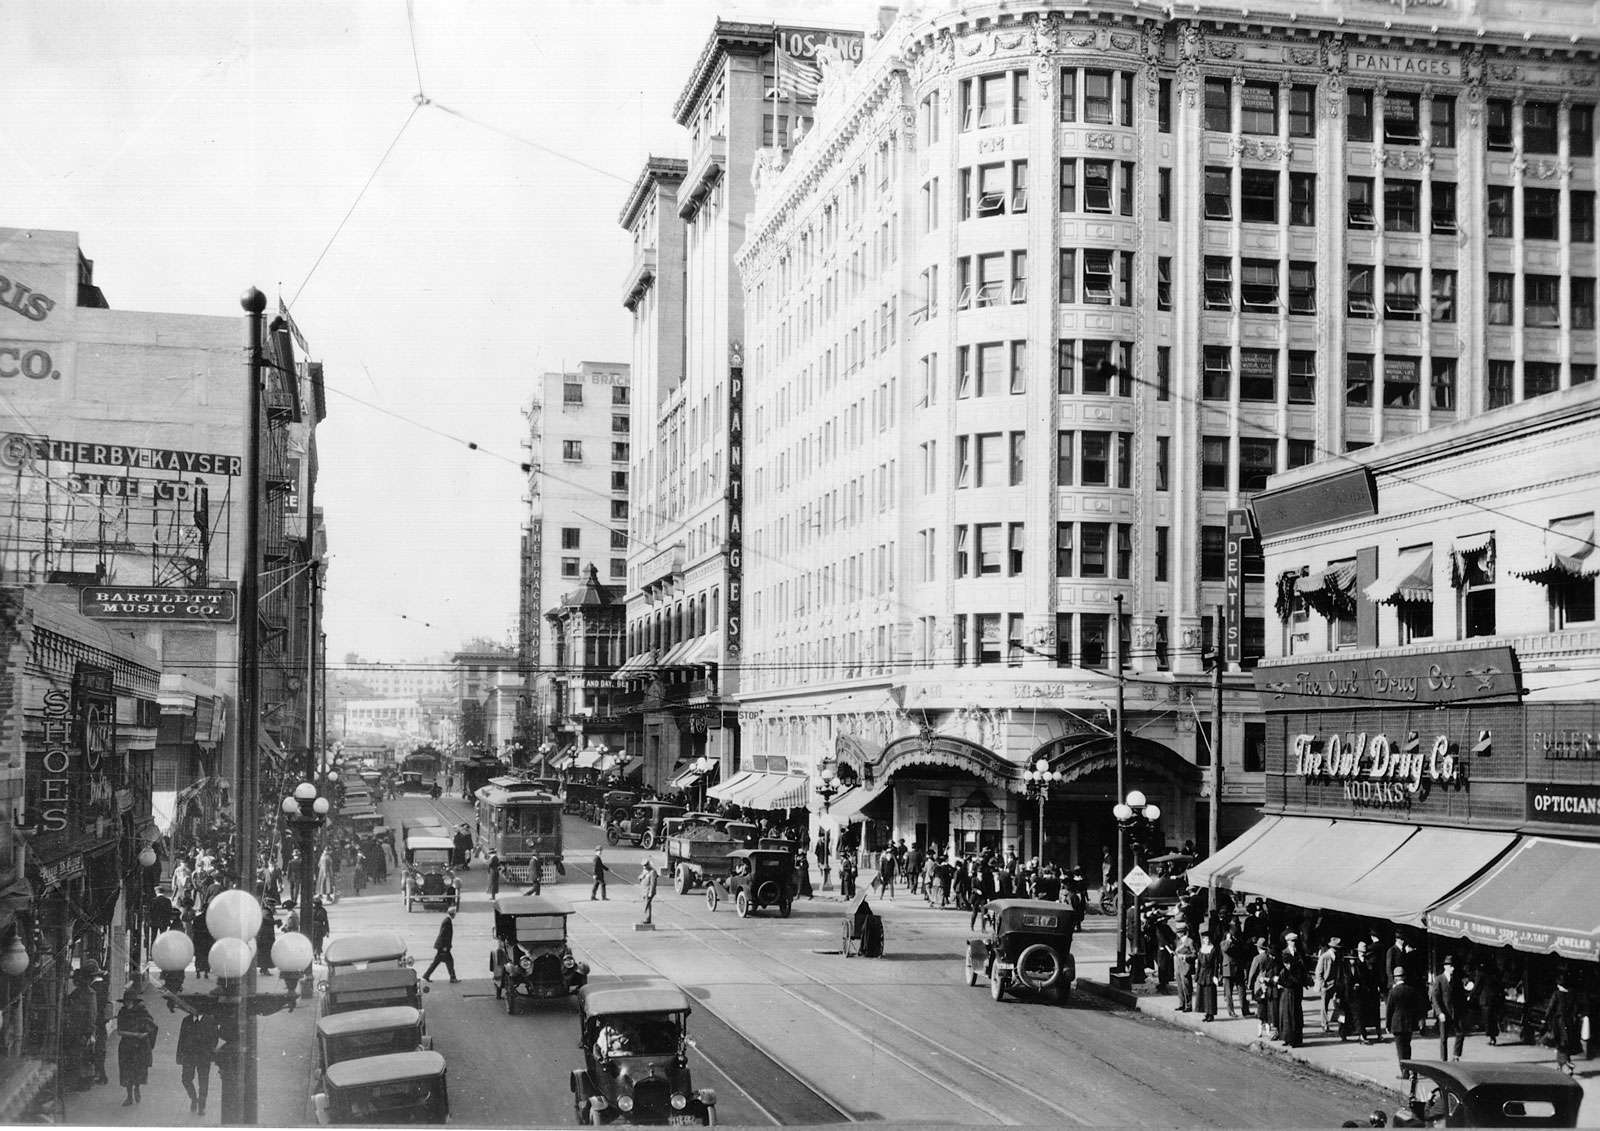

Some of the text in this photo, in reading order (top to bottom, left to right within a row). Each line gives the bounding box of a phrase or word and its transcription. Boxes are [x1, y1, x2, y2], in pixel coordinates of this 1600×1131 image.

[780, 33, 815, 56] LOS
[1356, 55, 1451, 75] PANTAGES
[729, 379, 741, 635] PANTAGES
[96, 592, 222, 604] BARTLETT
[101, 603, 220, 614] MUSIC CO.
[1228, 541, 1238, 656] DENTIST
[532, 616, 540, 668] SHOPS
[1296, 672, 1321, 695] The
[1328, 668, 1359, 694] Owl
[1374, 668, 1420, 700] Drug
[739, 711, 758, 720] STOP
[1533, 732, 1592, 752] FULLER
[43, 690, 72, 831] SHOES
[1295, 732, 1457, 792] The Owl Drug Co.
[1344, 780, 1404, 803] KODAKS
